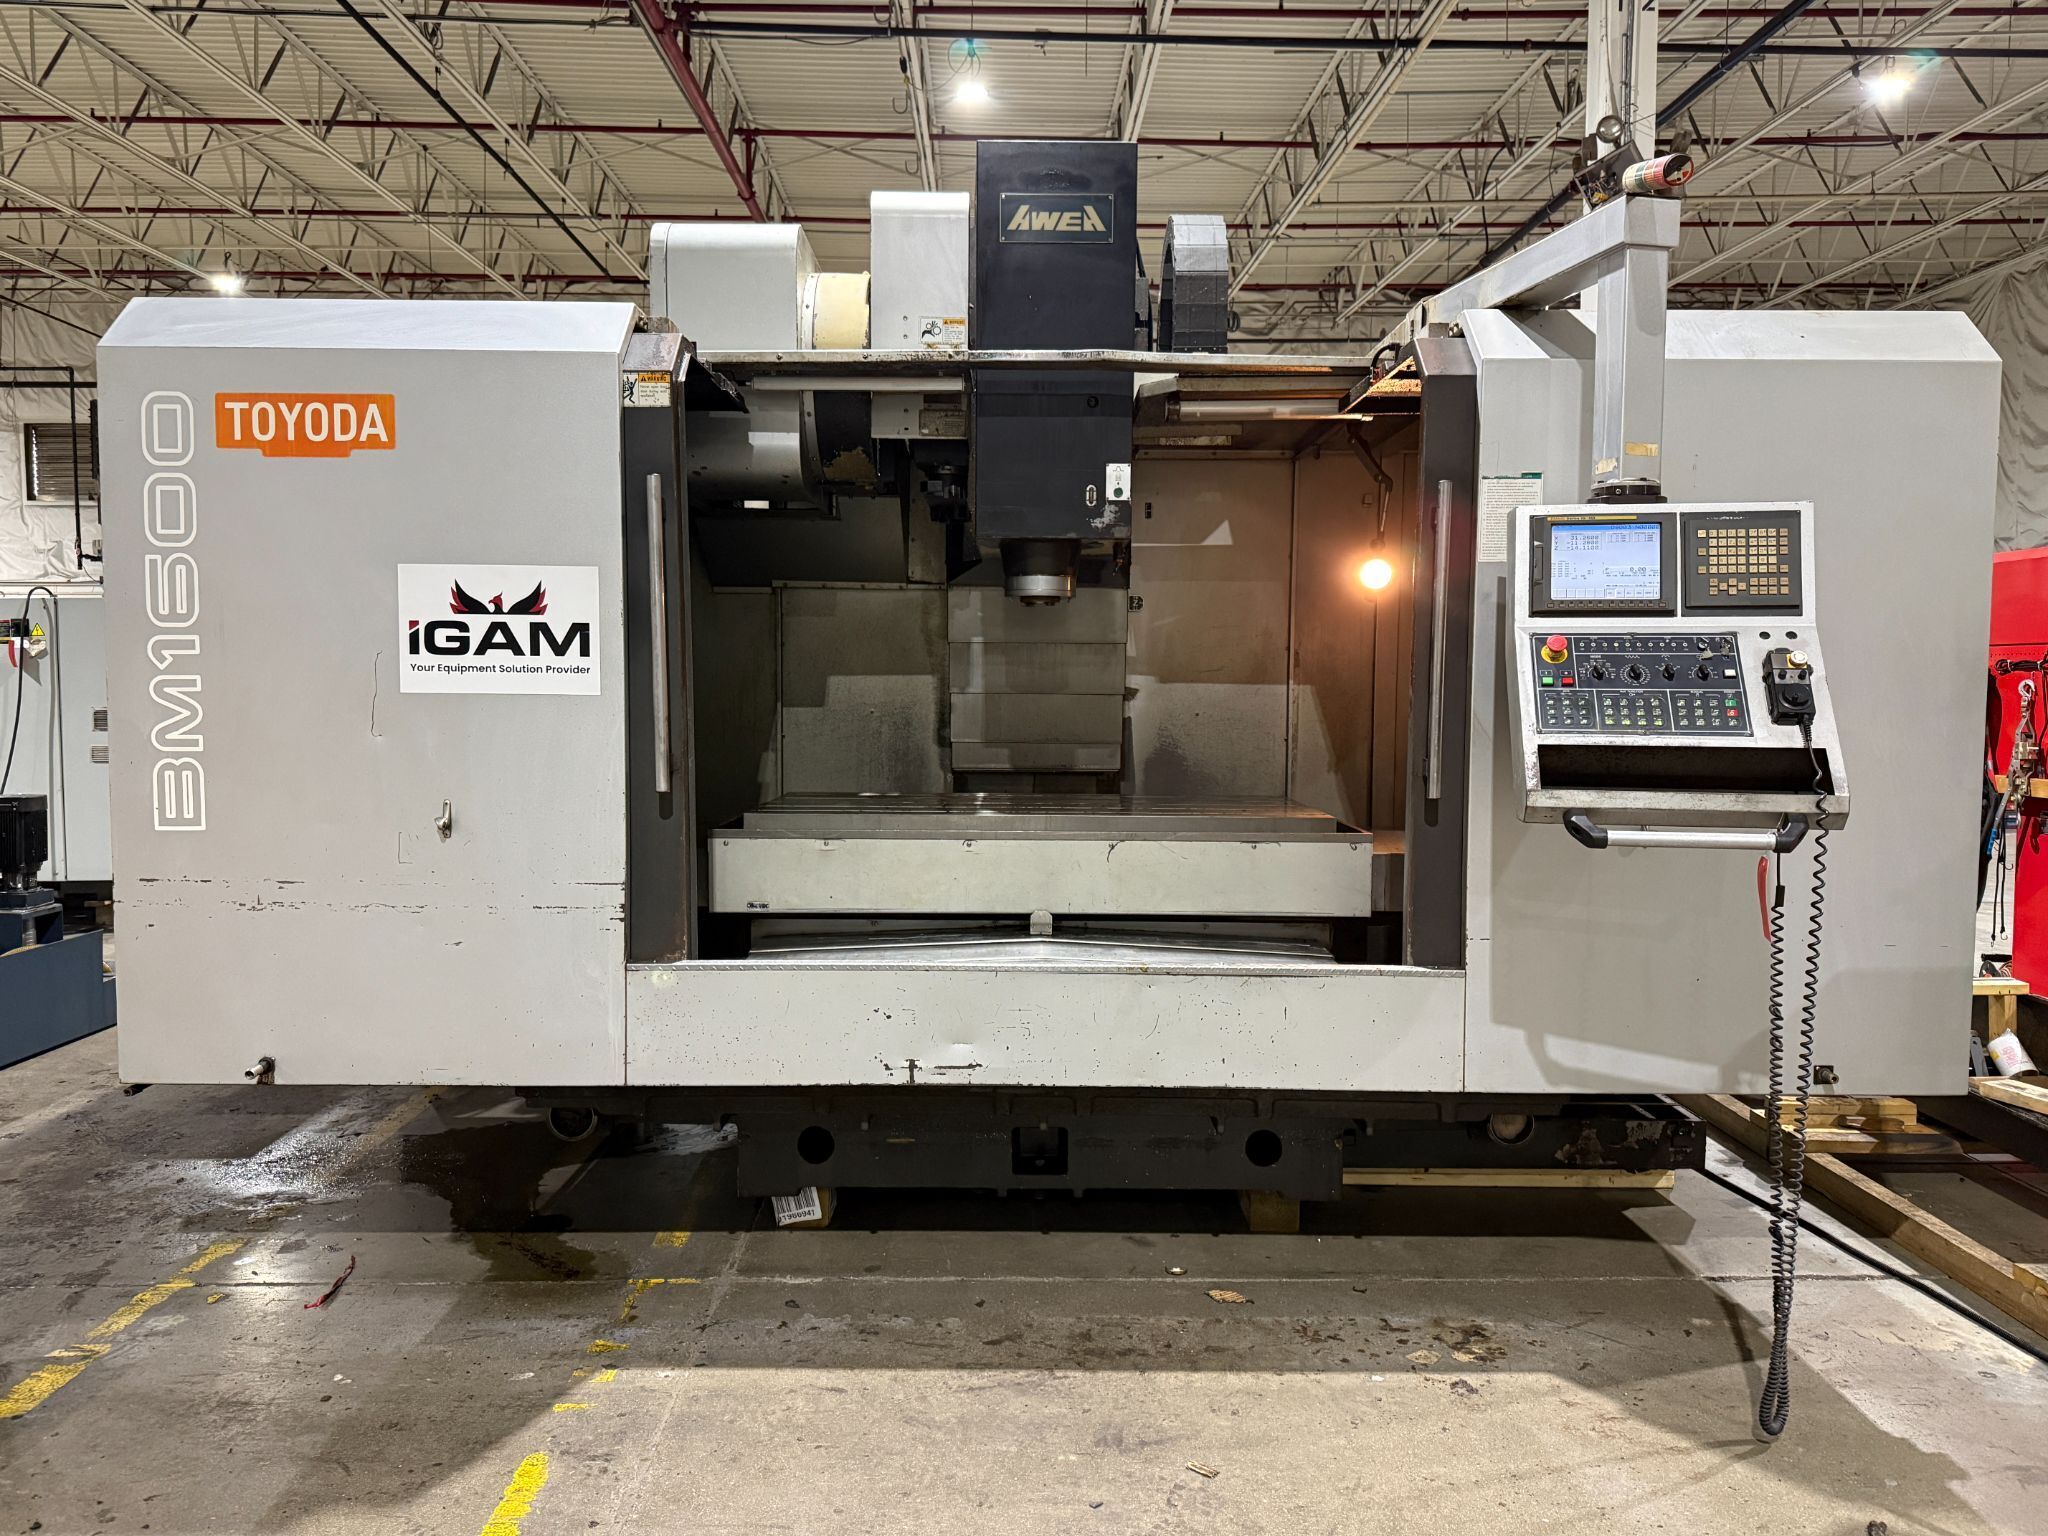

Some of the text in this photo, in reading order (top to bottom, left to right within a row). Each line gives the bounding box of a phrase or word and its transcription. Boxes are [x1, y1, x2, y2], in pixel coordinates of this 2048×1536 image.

[1006, 204, 1107, 232] AWEA
[224, 401, 389, 442] TOYODA
[141, 391, 206, 831] BM1600
[410, 663, 591, 675] Your Equipment Solution Provider
